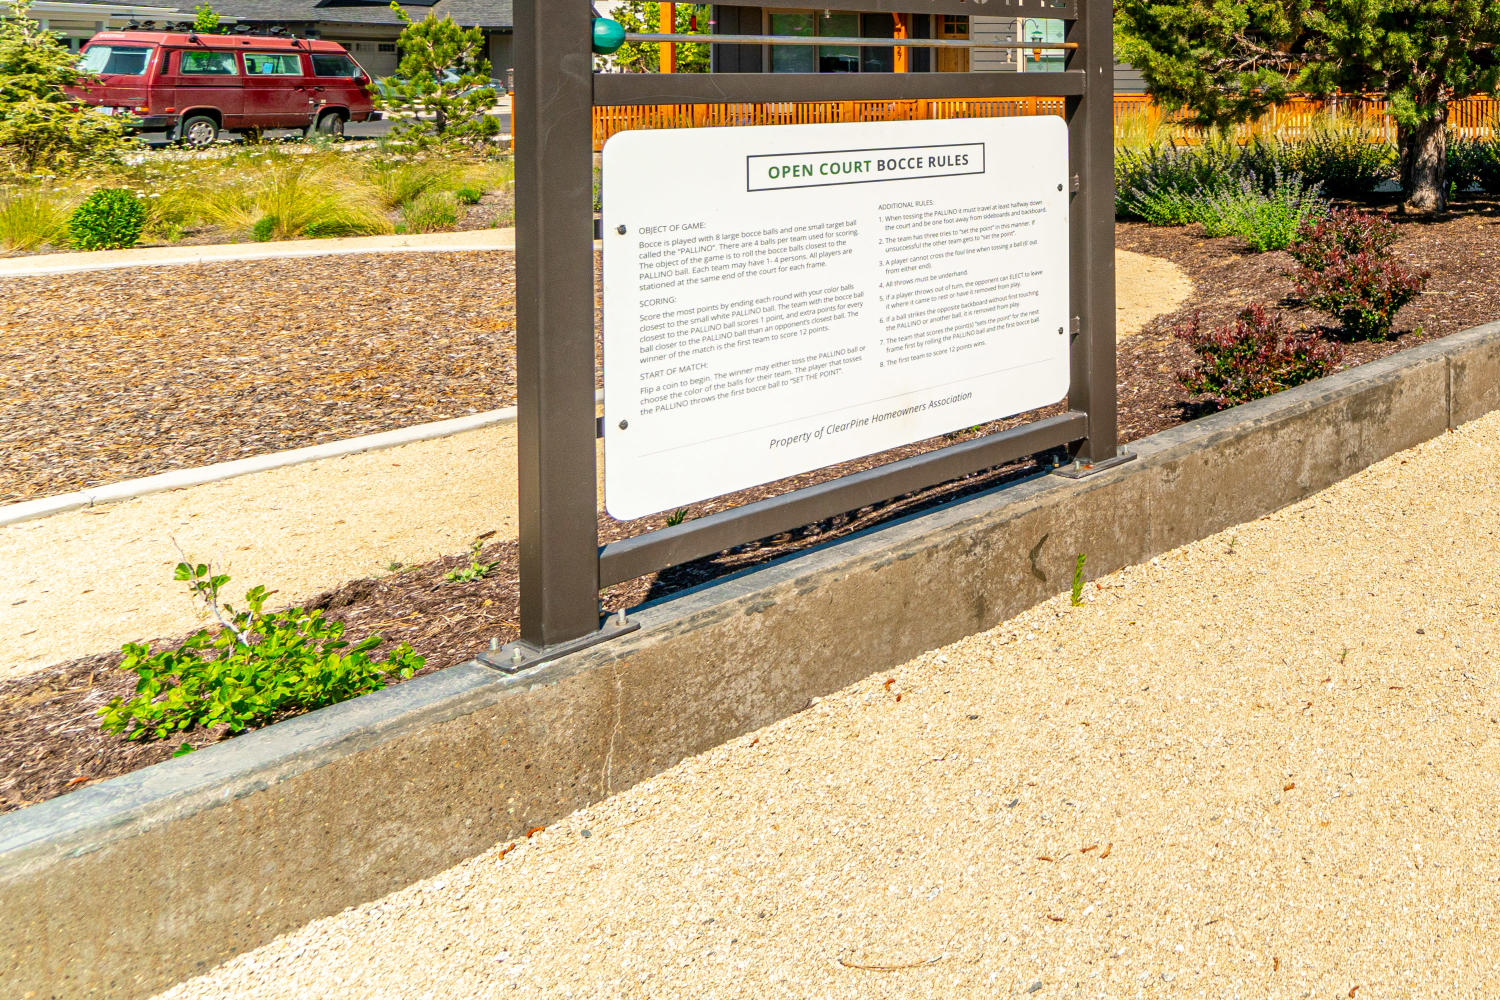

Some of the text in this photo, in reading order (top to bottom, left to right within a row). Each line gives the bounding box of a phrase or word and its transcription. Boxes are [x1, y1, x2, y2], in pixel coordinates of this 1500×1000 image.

[768, 155, 968, 179] OPEN COURT BOCCE RULES
[639, 225, 667, 234] OBJECT
[639, 241, 662, 249] Bocce
[672, 236, 696, 247] played
[698, 234, 713, 242] with
[722, 233, 739, 241] large
[826, 221, 844, 229] target
[639, 250, 661, 259] called
[664, 249, 676, 257] the
[760, 238, 775, 246] balls
[808, 232, 824, 240] used
[639, 262, 654, 270] The
[656, 259, 679, 269] object
[681, 257, 688, 265] of
[690, 256, 702, 264] the
[704, 255, 724, 264] game
[789, 244, 804, 252] balls
[805, 242, 827, 250] closest
[639, 280, 675, 291] stationed
[686, 277, 698, 285] the
[700, 275, 720, 283] same
[722, 272, 735, 280] end
[746, 269, 757, 277] the
[759, 267, 776, 275] court
[789, 263, 805, 271] each
[640, 269, 673, 280] PALLINO
[692, 265, 709, 274] Each
[819, 250, 841, 259] players
[640, 314, 661, 322] Score
[677, 308, 695, 316] most
[697, 305, 719, 315] points
[720, 303, 729, 311] by
[730, 300, 754, 308] ending
[755, 296, 771, 304] each
[773, 293, 792, 302] round
[794, 290, 807, 298] with
[809, 290, 822, 298] your
[640, 323, 665, 333] closest
[676, 319, 688, 327] the
[690, 315, 709, 324] small
[711, 313, 730, 321] white
[732, 307, 761, 318] PALLINO
[778, 303, 790, 311] The
[809, 298, 822, 306] with
[835, 294, 852, 302] bocce
[854, 291, 864, 299] ball
[640, 354, 666, 364] winner
[669, 351, 676, 359] of
[678, 349, 690, 357] the
[692, 344, 715, 355] match
[724, 341, 736, 349] the
[737, 339, 751, 347] first
[752, 336, 770, 344] team
[780, 331, 797, 339] score
[640, 369, 664, 380] START
[666, 367, 676, 375] OF
[640, 408, 653, 416] the
[655, 399, 688, 413] PALLINO
[690, 395, 715, 405] throws
[717, 392, 729, 400] the
[731, 388, 744, 397] first
[746, 385, 766, 394] bocce
[768, 381, 780, 389] ball
[806, 373, 817, 381] THE
[770, 392, 972, 449] Property of ClearPine Homeowners Association
